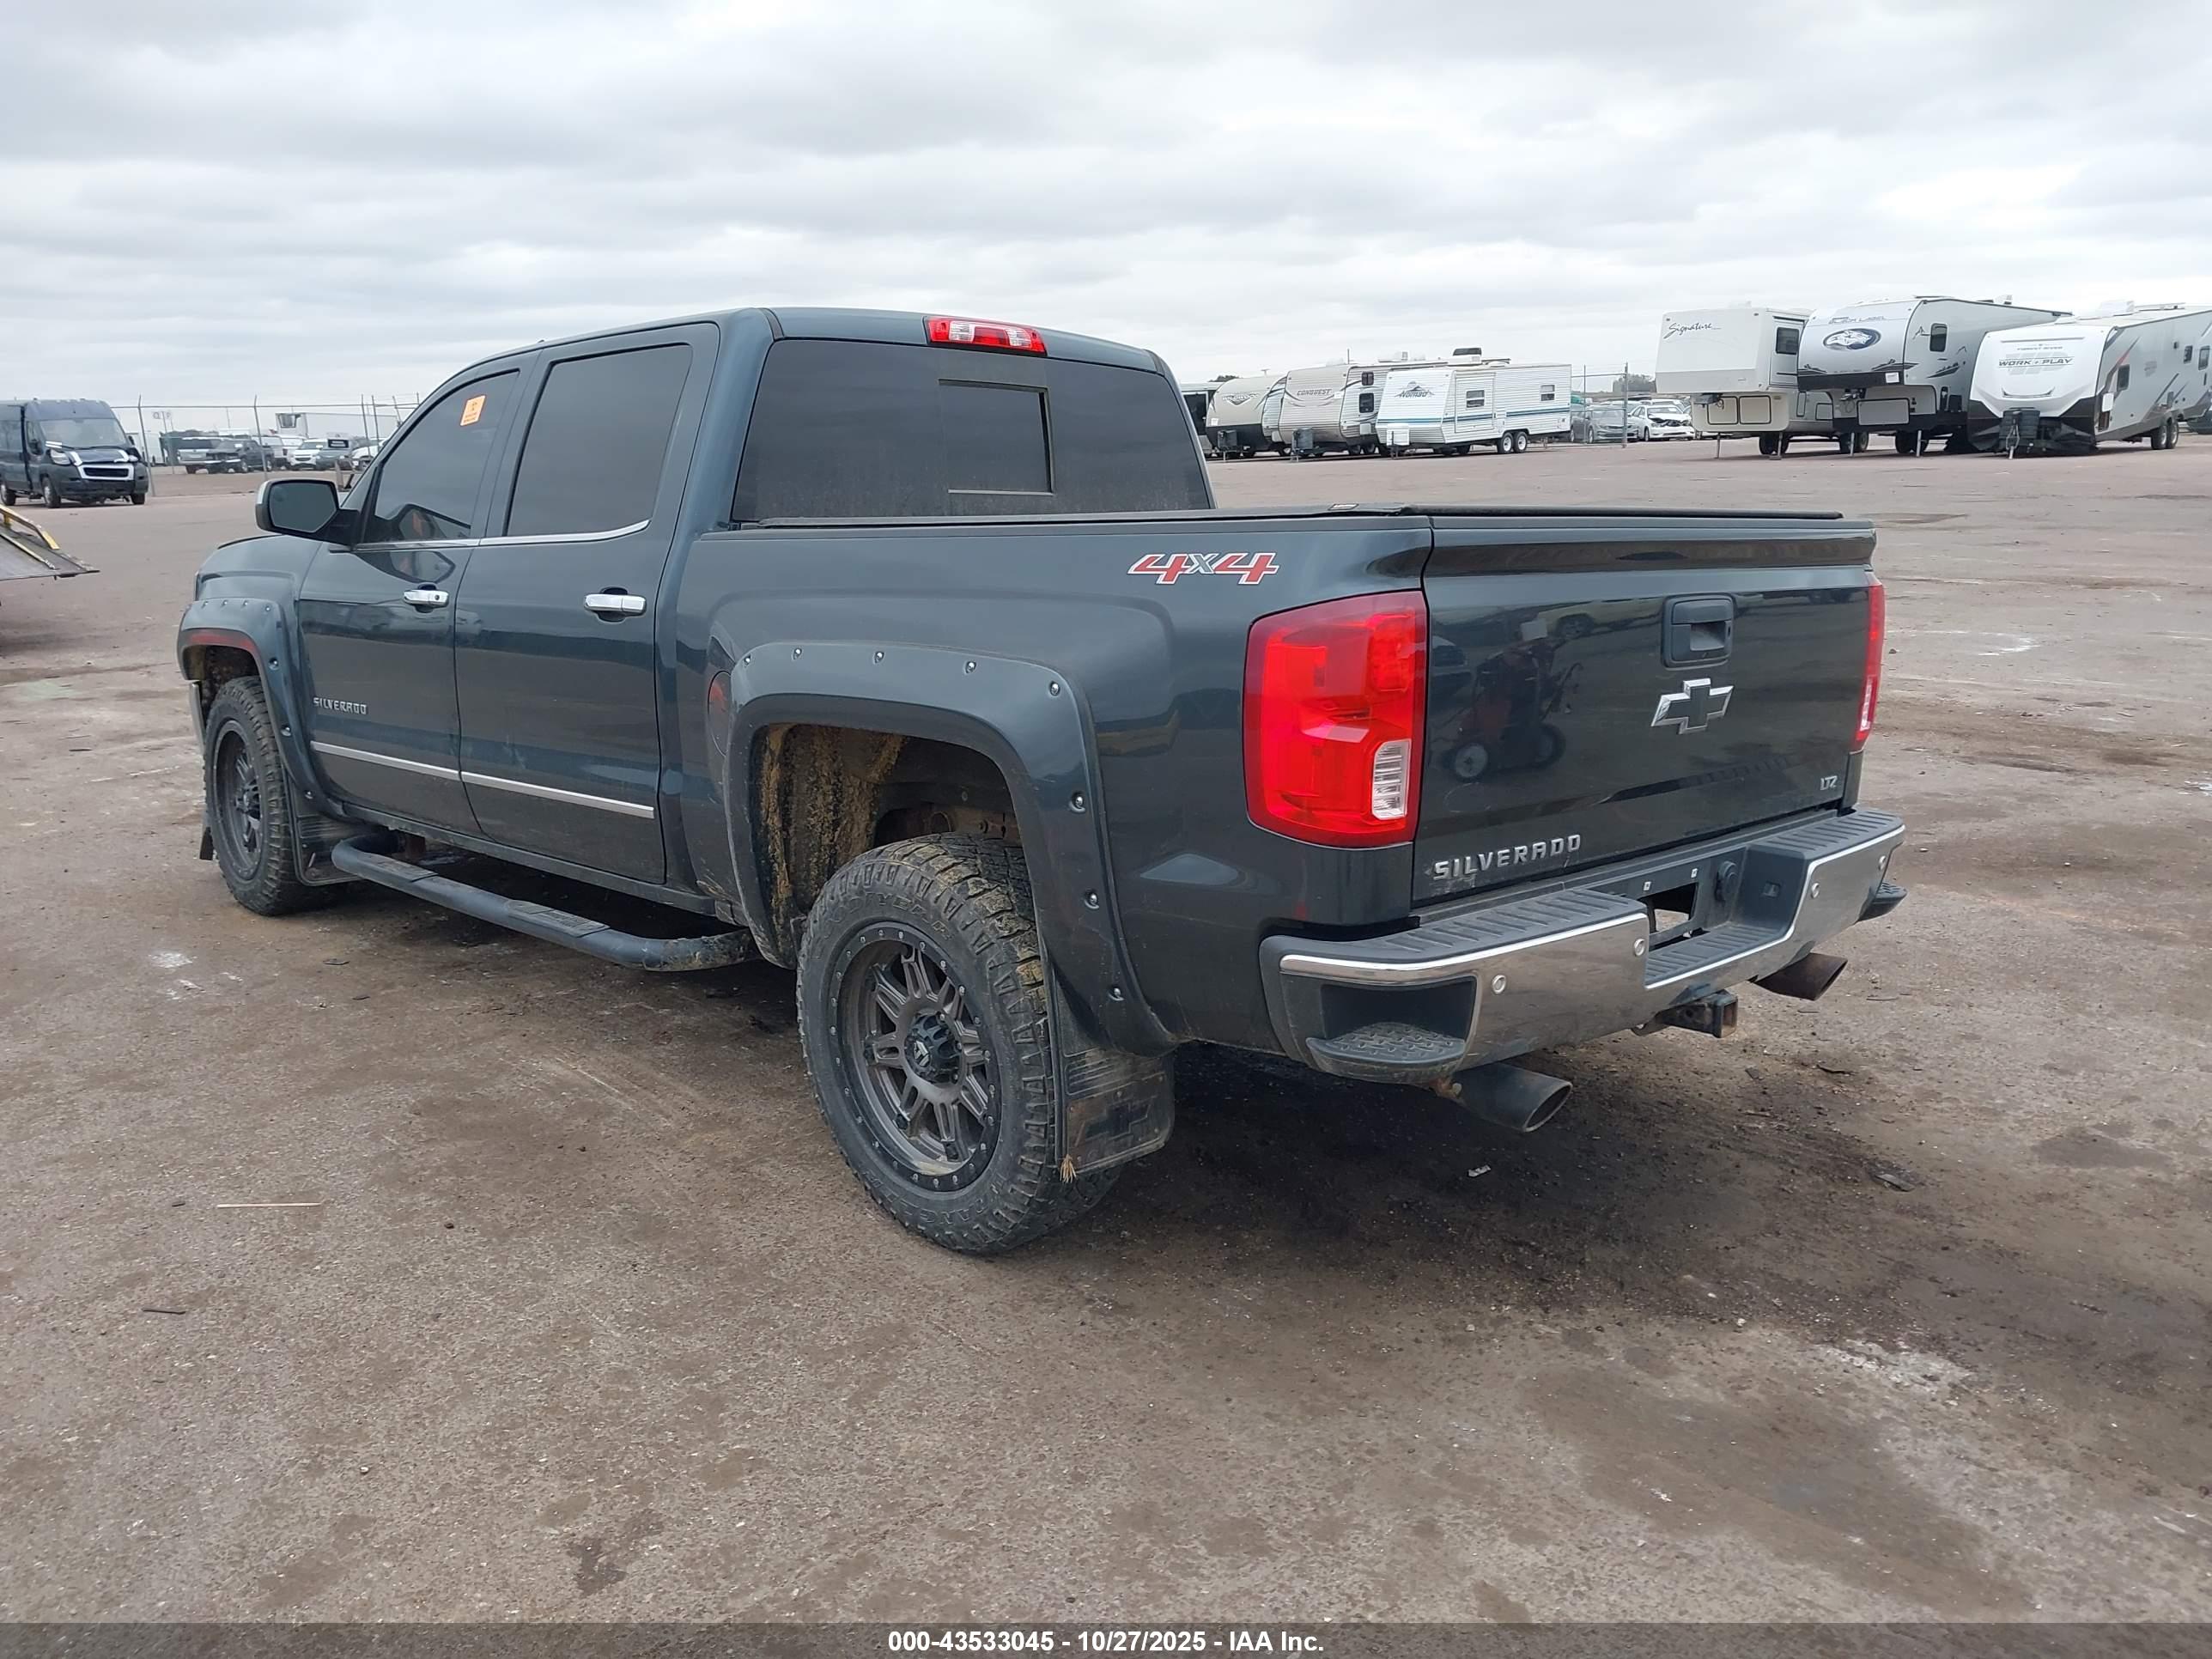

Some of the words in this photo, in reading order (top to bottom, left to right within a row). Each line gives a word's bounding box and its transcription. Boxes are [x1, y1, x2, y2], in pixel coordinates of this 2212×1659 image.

[1663, 322, 1714, 339] Signature
[1297, 388, 1333, 397] CONQUEST
[1400, 390, 1429, 398] Nomad
[313, 696, 368, 715] SILVERADO
[1820, 775, 1838, 791] LTZ
[1433, 834, 1581, 881] SILVERADO
